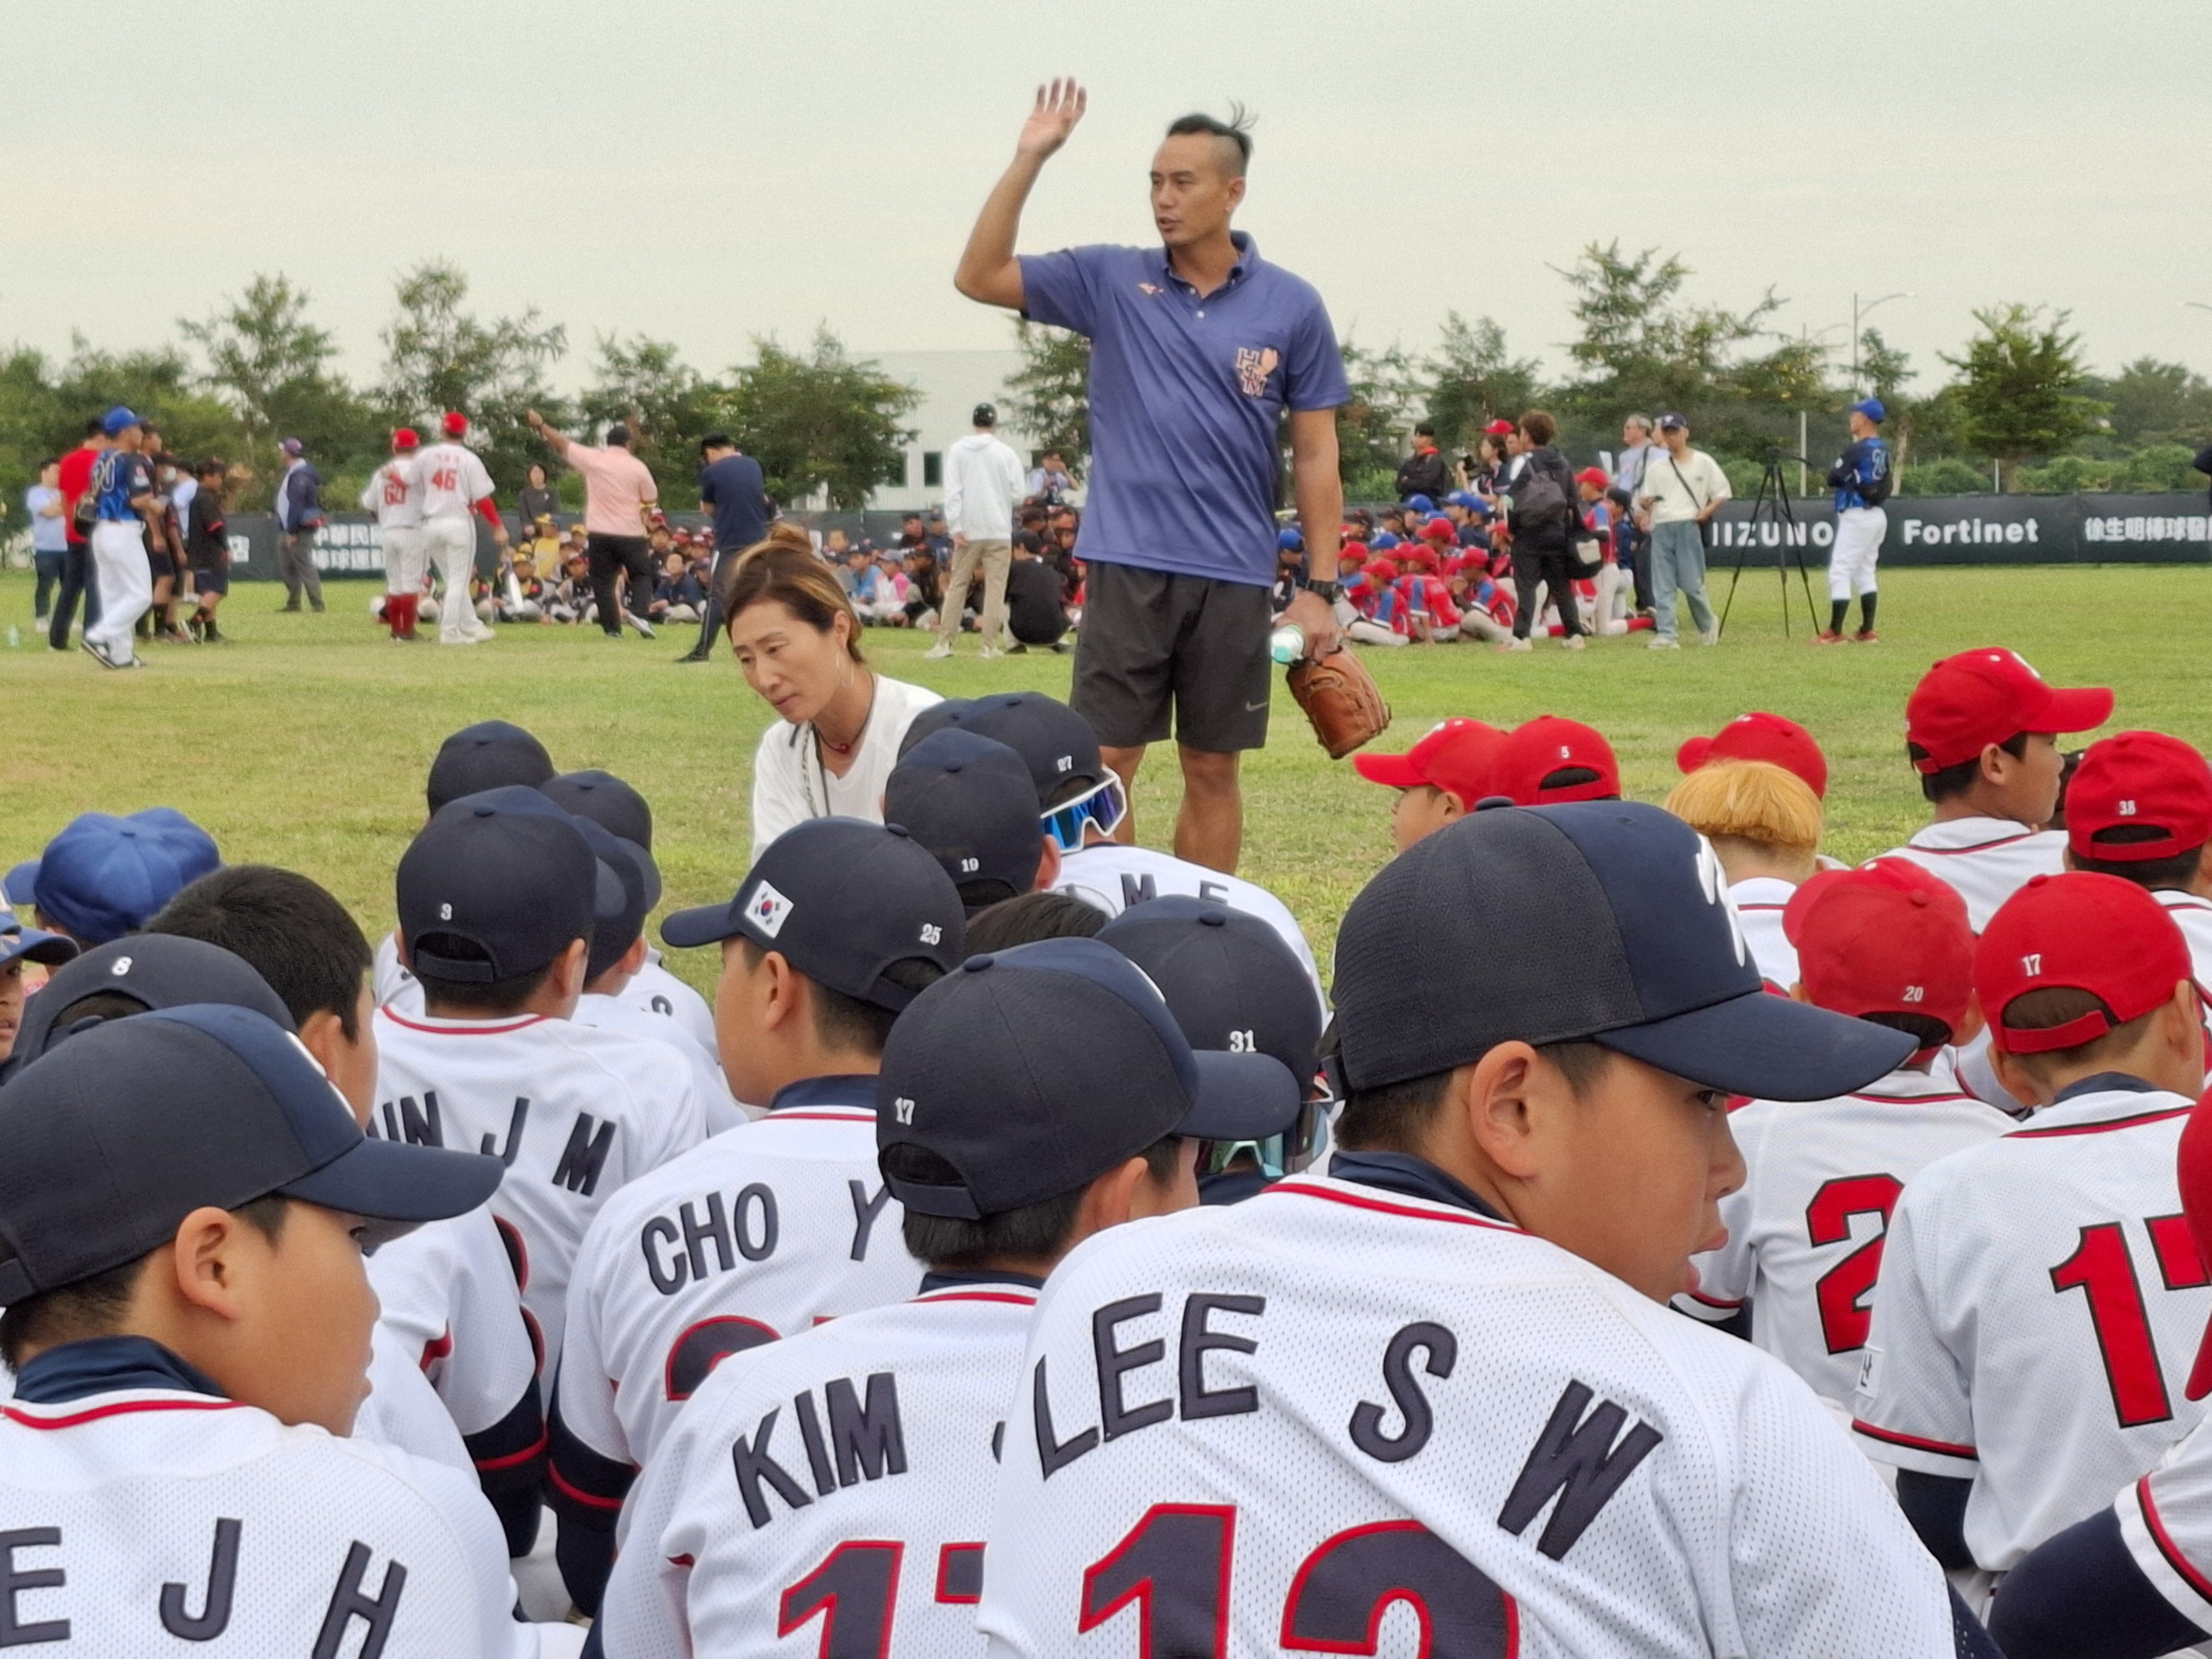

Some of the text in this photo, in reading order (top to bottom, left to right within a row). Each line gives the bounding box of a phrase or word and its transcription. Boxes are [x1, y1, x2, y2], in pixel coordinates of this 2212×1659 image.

[432, 468, 456, 491] 46
[1904, 518, 2038, 544] Fortinet
[2085, 517, 2212, 541] 徐生明棒球發
[1121, 873, 1157, 908] M
[919, 923, 942, 946] 25
[2023, 954, 2041, 976] 17
[1903, 986, 1924, 1002] 20
[1230, 1029, 1257, 1053] 31
[895, 1097, 915, 1126] 17
[365, 1090, 443, 1148] IN
[552, 1111, 616, 1197] M
[641, 1182, 779, 1296] CHO
[848, 1180, 891, 1262] Y
[1034, 1291, 1266, 1482] LEE
[1349, 1321, 1458, 1463] S
[1497, 1379, 1664, 1561] W
[732, 1372, 909, 1529] KIM
[159, 1517, 243, 1642] J
